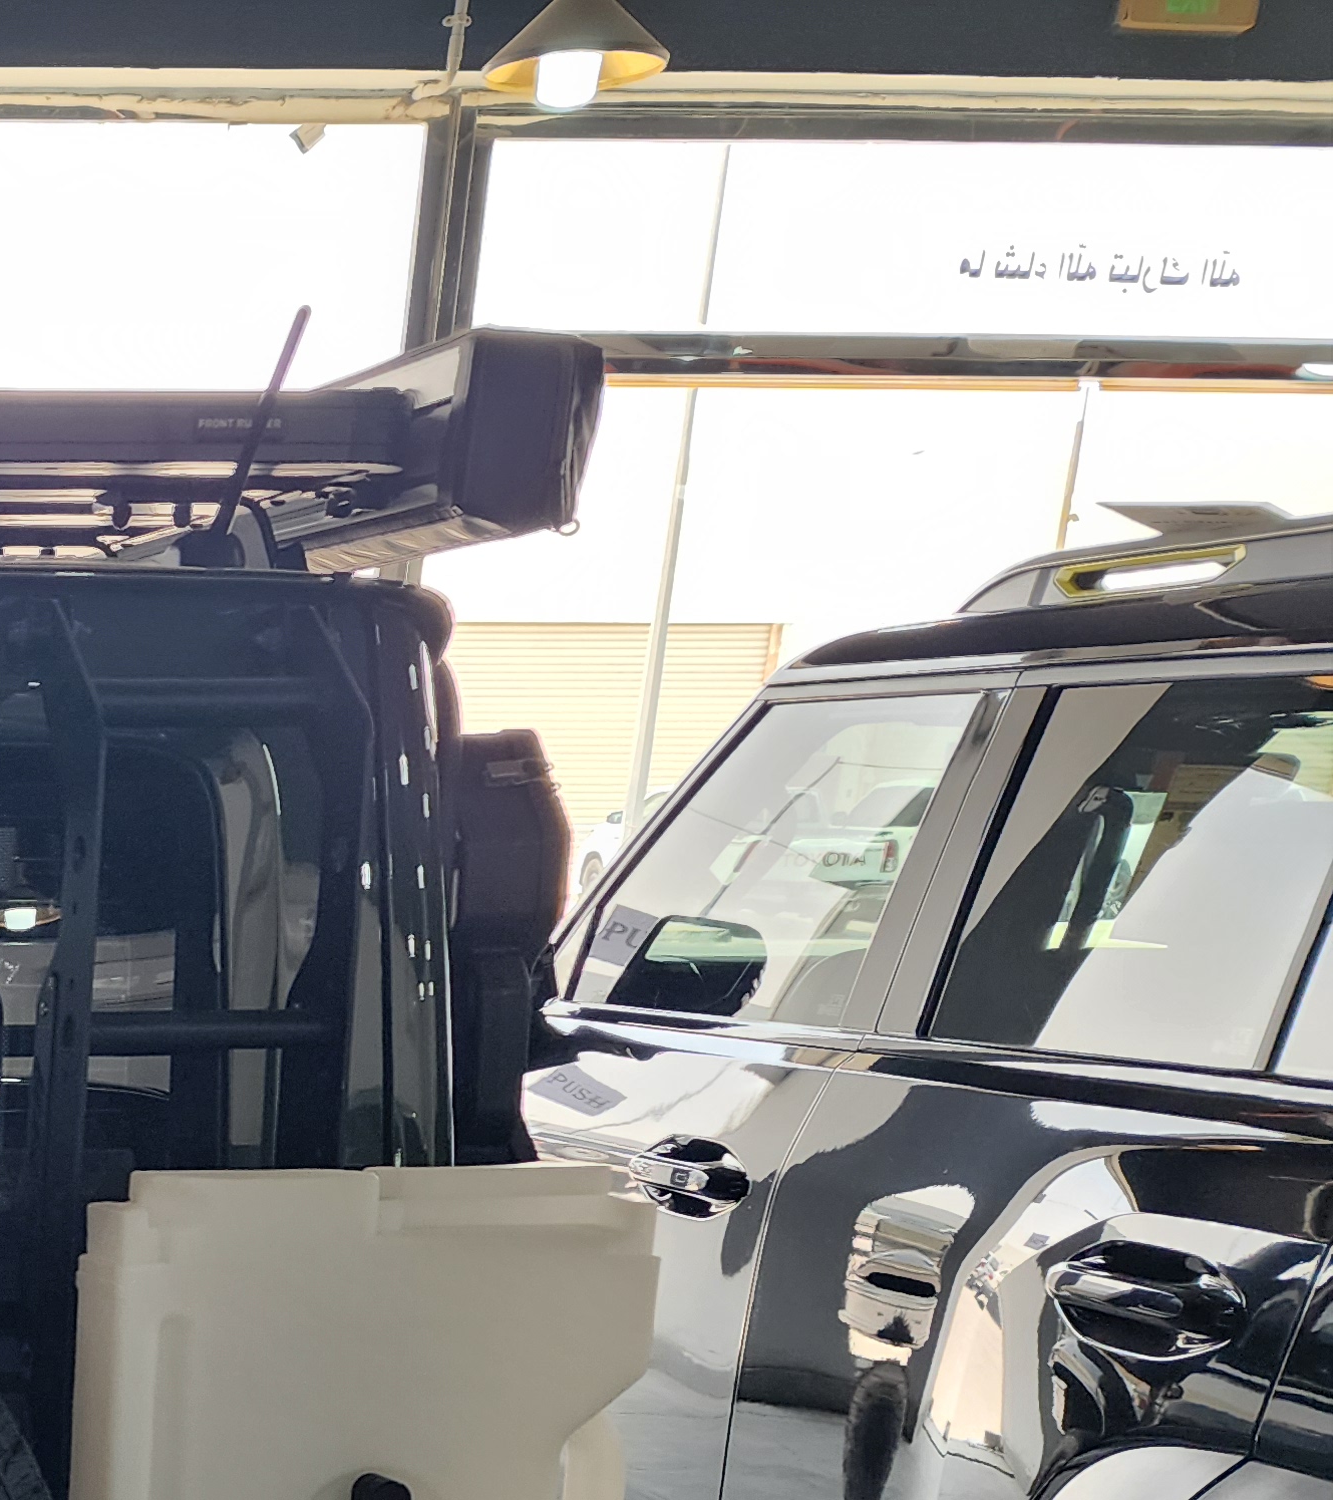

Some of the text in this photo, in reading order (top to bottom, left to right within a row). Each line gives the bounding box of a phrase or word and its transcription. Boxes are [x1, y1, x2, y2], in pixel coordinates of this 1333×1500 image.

[196, 417, 283, 429] FRONT RUER
[546, 1072, 612, 1109] PUSH
